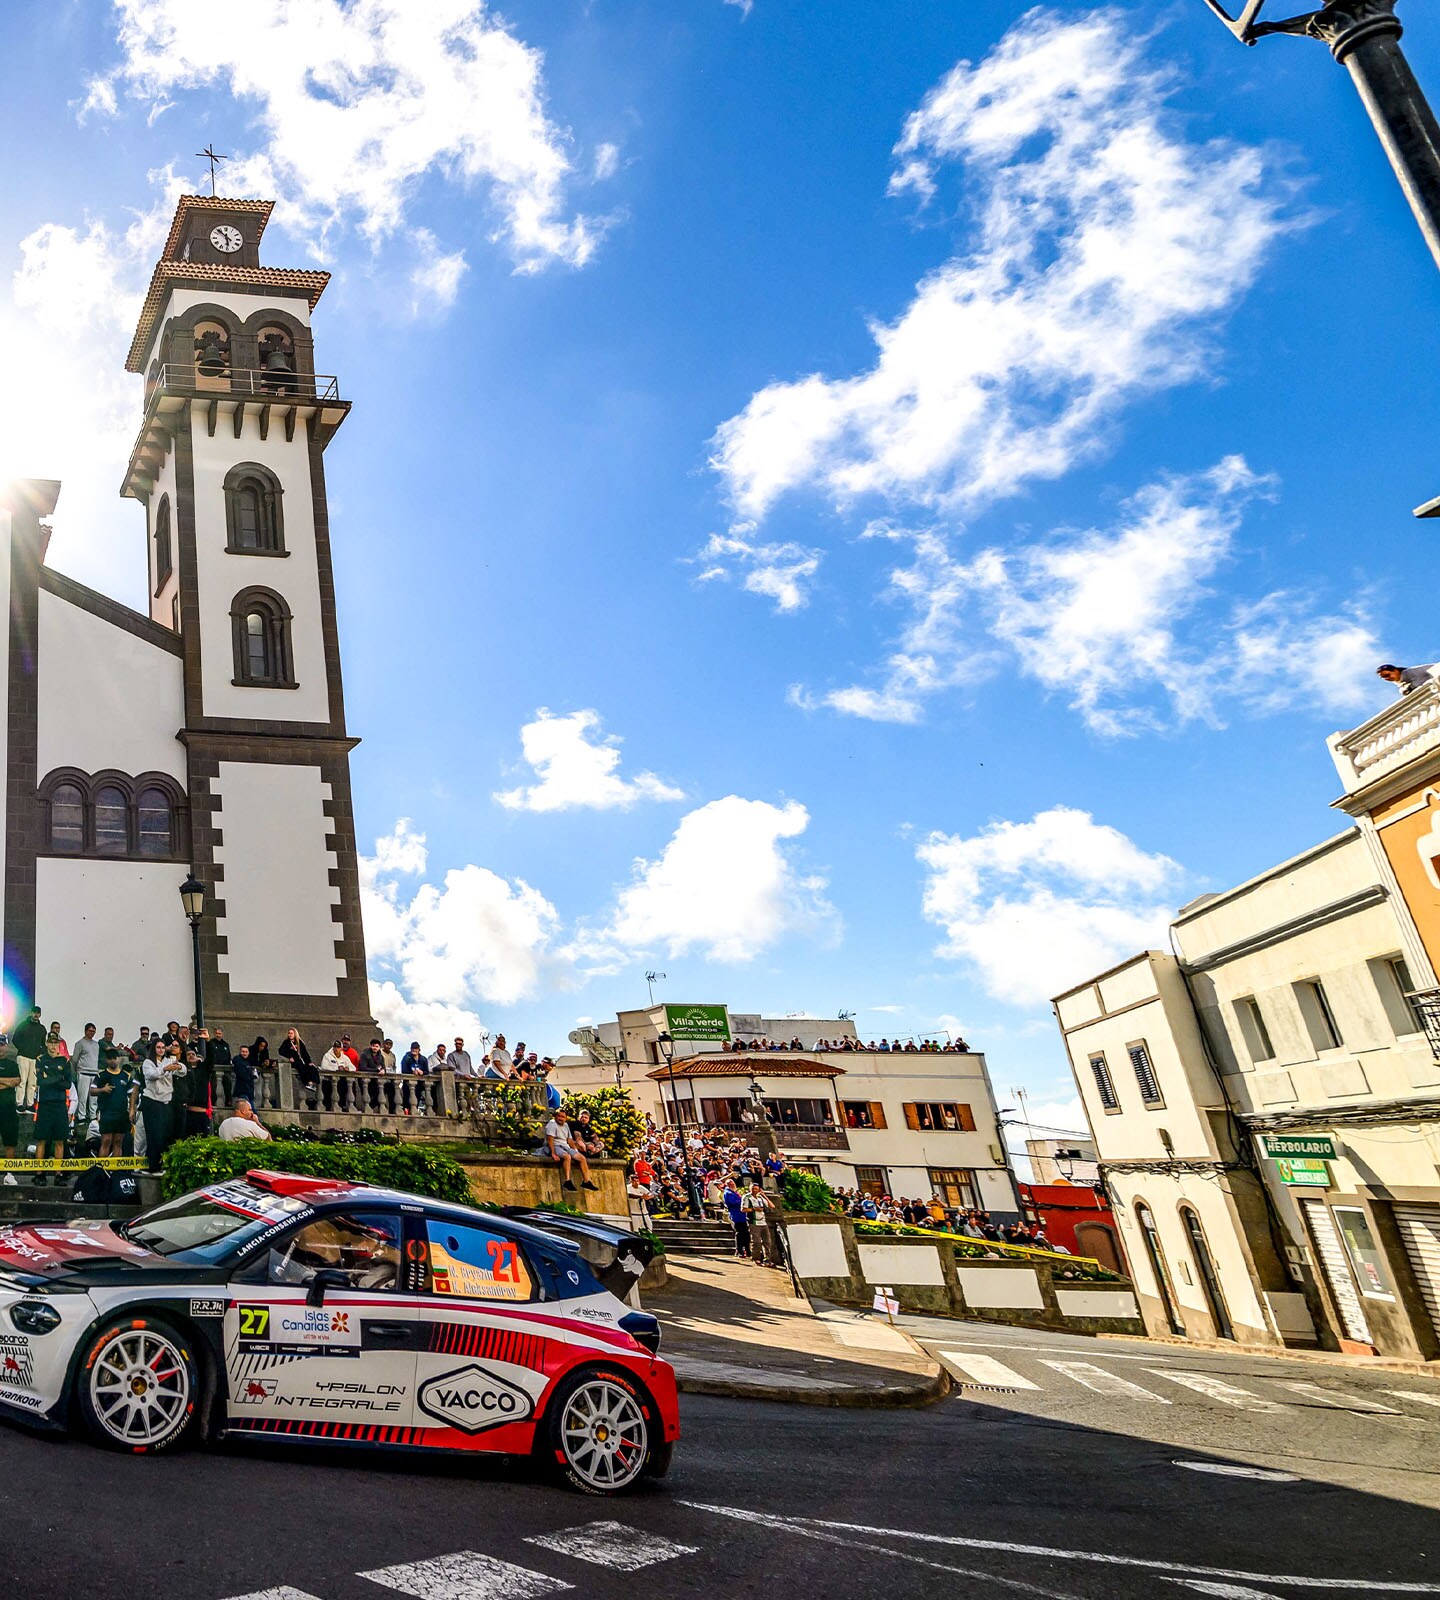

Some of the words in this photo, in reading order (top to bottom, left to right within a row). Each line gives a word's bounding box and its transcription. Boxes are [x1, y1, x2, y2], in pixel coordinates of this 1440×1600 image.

[671, 1017, 694, 1026] Villa
[695, 1018, 724, 1027] verde
[1266, 1141, 1332, 1154] HERBOLARIO
[4, 1159, 23, 1168] ZONA
[24, 1160, 54, 1168] PUBLICO
[60, 1159, 80, 1168] ZONA
[116, 1158, 135, 1167] ZONA
[485, 1240, 521, 1284] 27
[239, 1308, 270, 1335] 27
[304, 1310, 330, 1322] Islas
[281, 1319, 330, 1332] Canarias
[0, 1335, 29, 1345] sparco
[316, 1381, 407, 1396] YPSILON
[274, 1395, 402, 1412] INTEGRALE
[435, 1389, 516, 1413] YACCO
